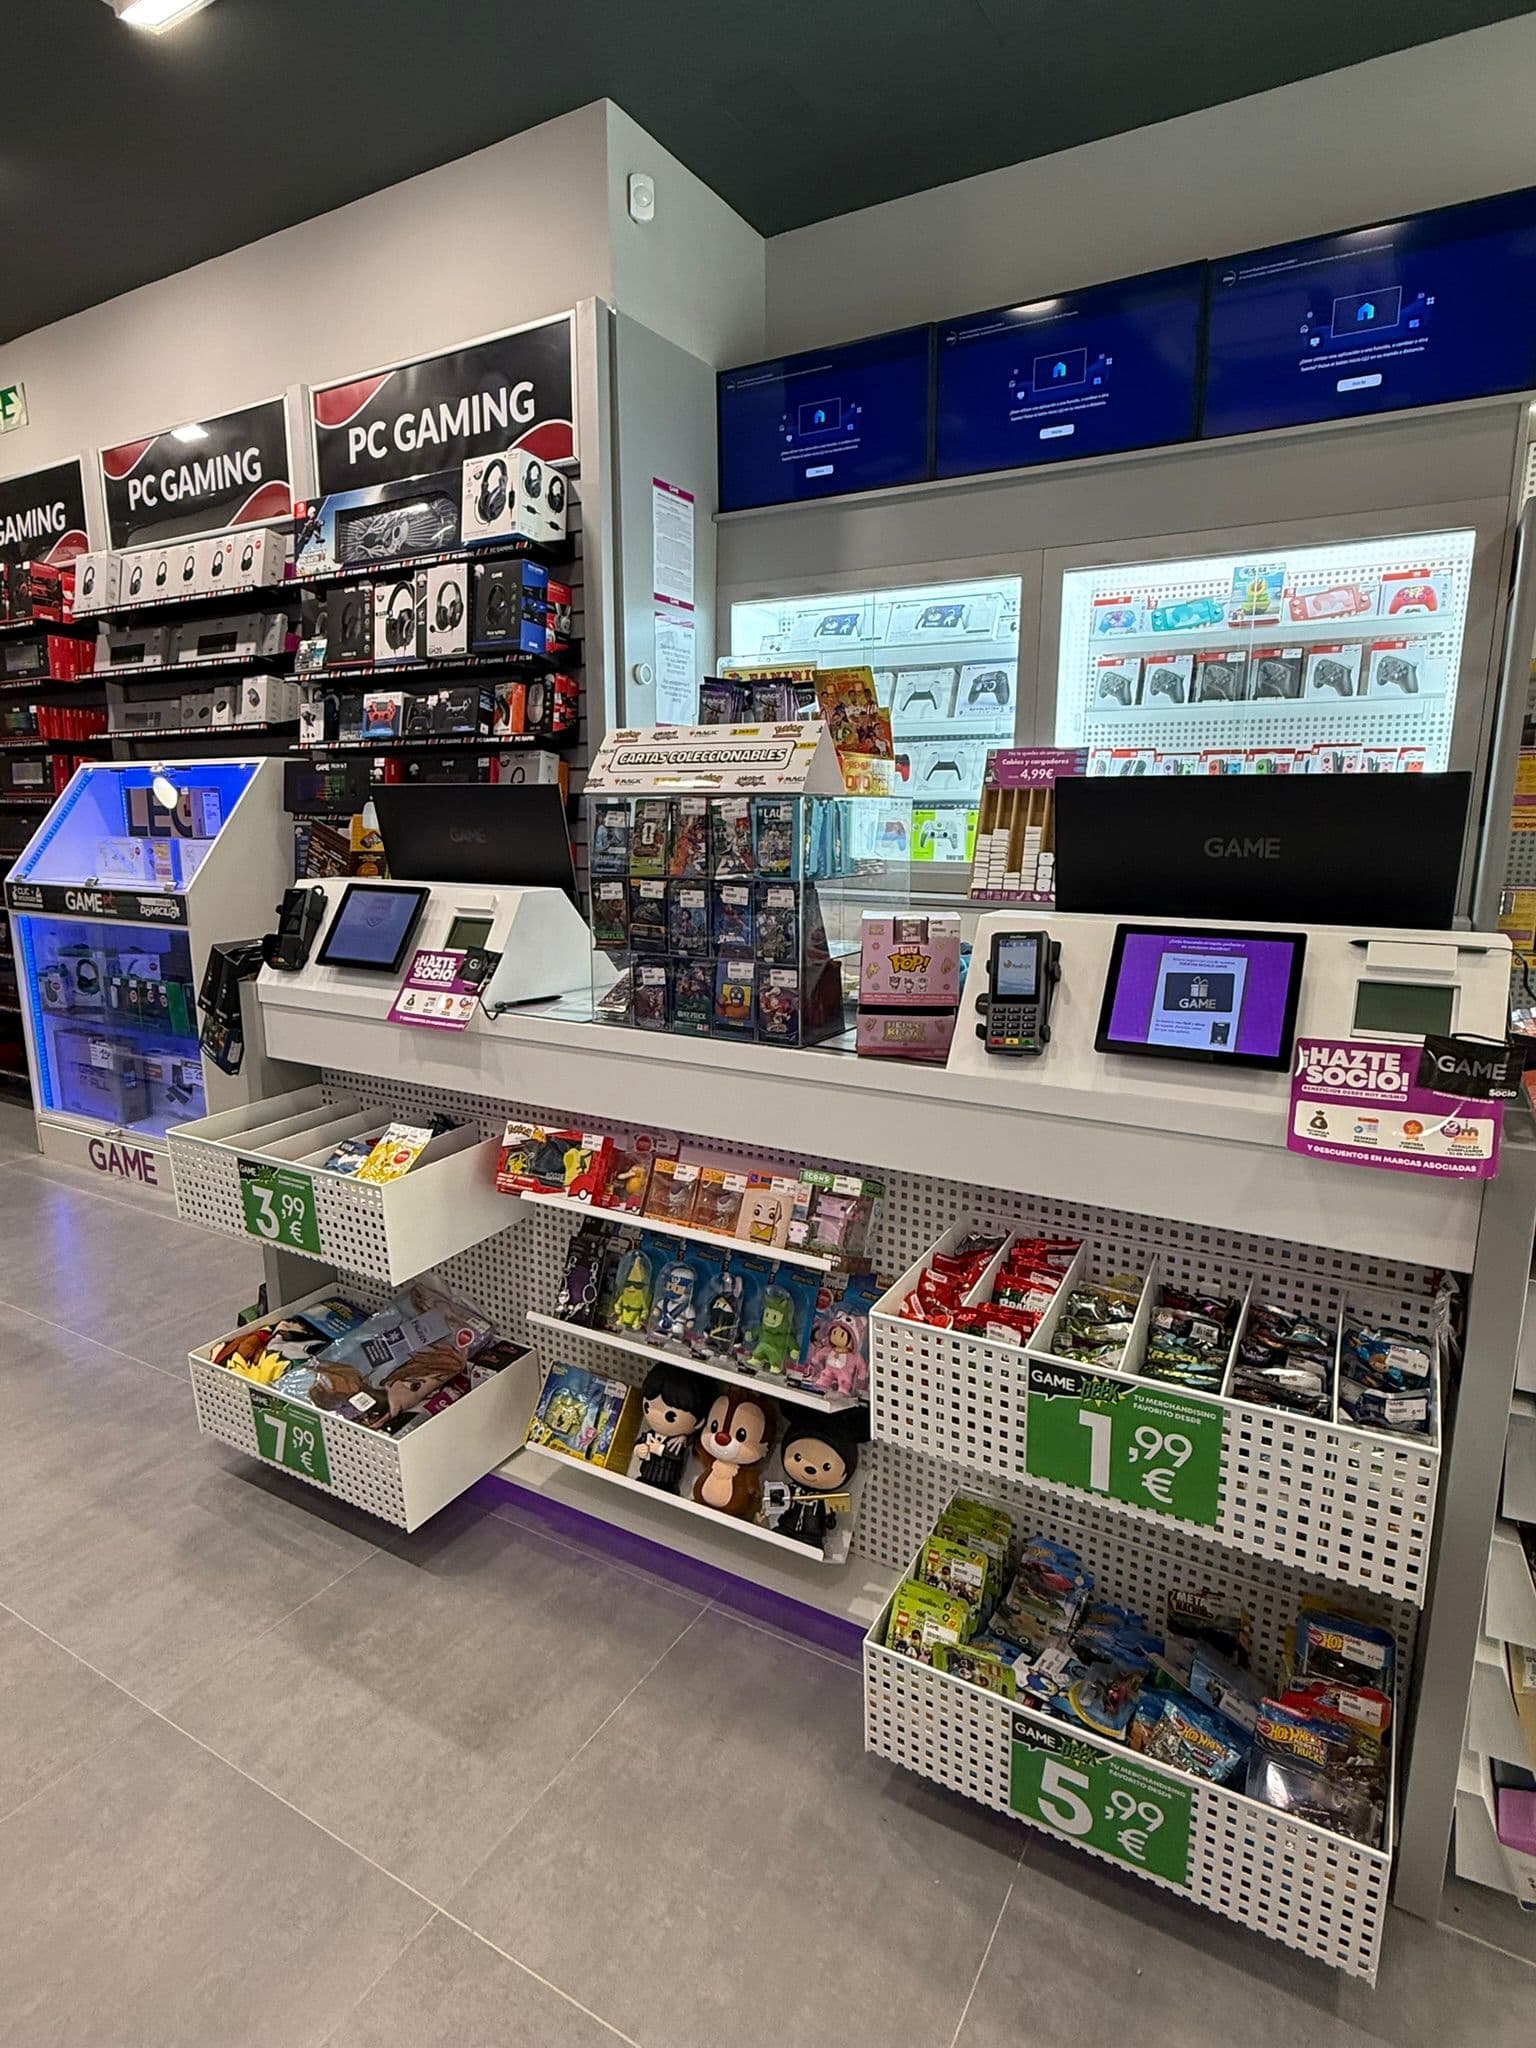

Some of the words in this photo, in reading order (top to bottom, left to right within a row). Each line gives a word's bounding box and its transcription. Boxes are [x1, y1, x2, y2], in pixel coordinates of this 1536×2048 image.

[348, 420, 388, 465] PC
[394, 381, 535, 453] GAMING
[128, 474, 157, 511] PC
[161, 447, 262, 501] GAMING
[748, 669, 812, 682] PANINI
[617, 751, 668, 766] CARTAS
[668, 747, 789, 765] COLECCIONABLES
[1002, 758, 1024, 766] Cables
[1031, 758, 1070, 767] cargadores
[1020, 768, 1055, 781] 4,99€
[1204, 837, 1281, 859] GAME
[65, 890, 103, 913] GAME
[414, 954, 457, 970] ¡HAZTE
[887, 953, 932, 974] POP!
[413, 966, 457, 982] SOCIO!
[1179, 998, 1216, 1009] GAME
[1303, 1046, 1401, 1073] ¡HAZTE
[1437, 1055, 1507, 1081] GAME
[1305, 1064, 1410, 1092] SOCIO!
[1488, 1088, 1517, 1098] Socio
[89, 1138, 159, 1186] GAME
[1313, 1145, 1369, 1160] DESCUENTOS
[1370, 1154, 1382, 1162] EN
[1383, 1156, 1422, 1167] MARCAS
[1423, 1161, 1477, 1173] ASOCIADAS
[1031, 1369, 1076, 1392] GAME
[1133, 1394, 1145, 1404] TU
[1146, 1397, 1217, 1421] MERCHANDISING
[1133, 1403, 1174, 1418] FAVORITO
[1175, 1413, 1202, 1425] DESDE
[1141, 1468, 1176, 1504] €
[1015, 1721, 1057, 1747] GAME
[1109, 1762, 1121, 1771] TU
[1121, 1766, 1186, 1798] MERCHANDISING
[1109, 1769, 1147, 1791] FAVORITO
[1117, 1828, 1149, 1861] €
